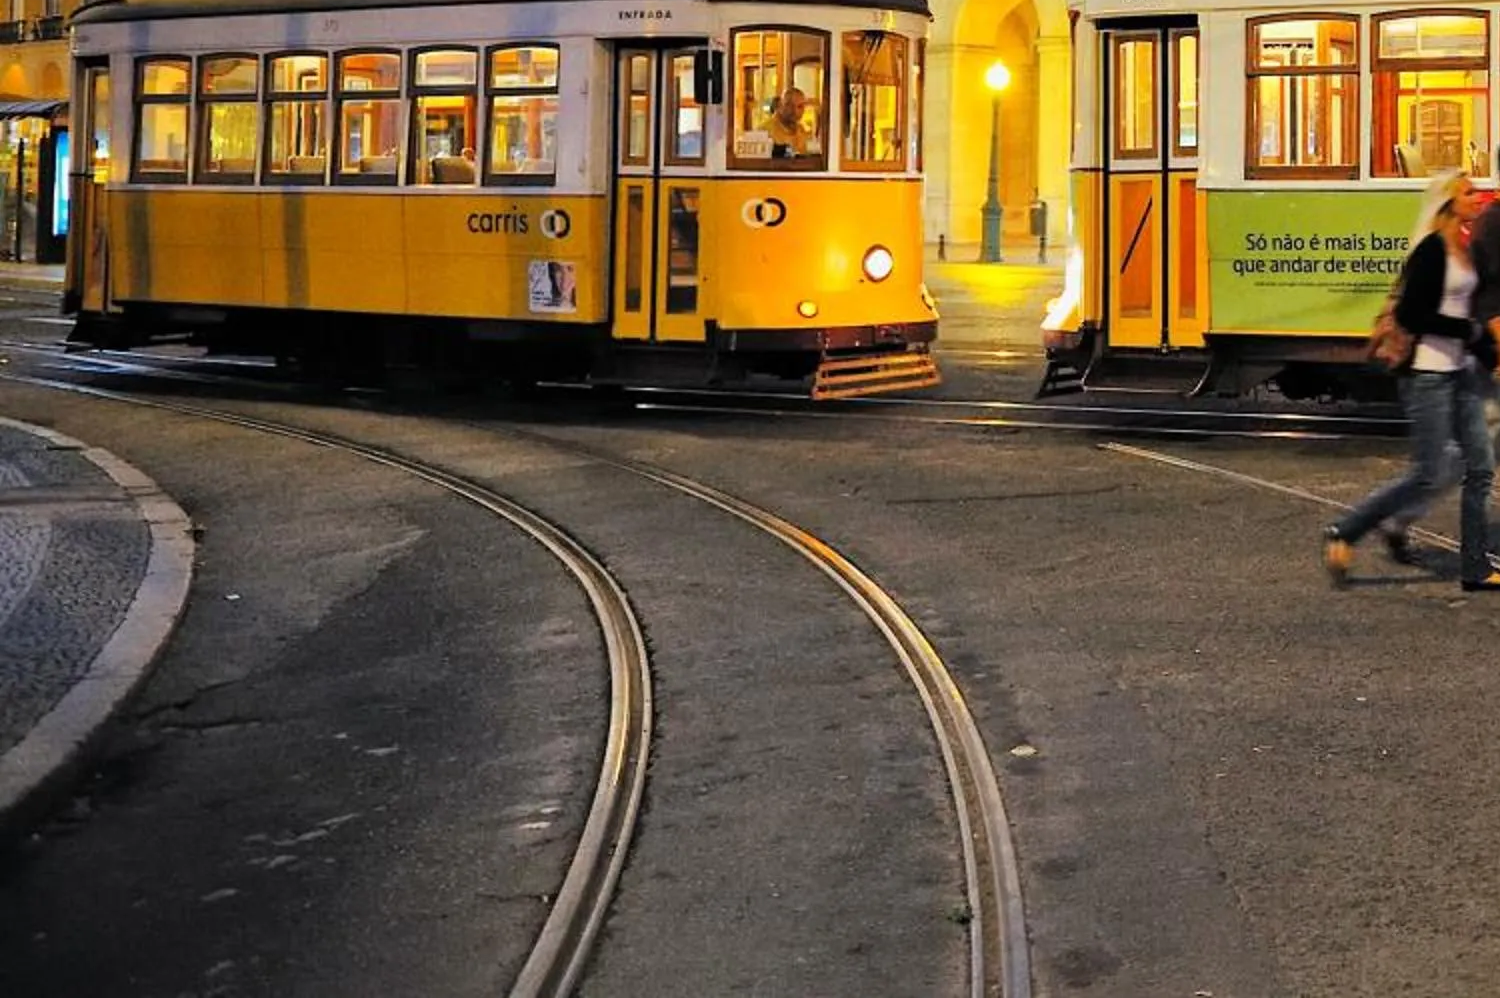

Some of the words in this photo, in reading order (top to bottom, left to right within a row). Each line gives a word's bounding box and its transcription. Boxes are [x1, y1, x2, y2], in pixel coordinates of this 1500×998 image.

[467, 204, 529, 235] carris
[1245, 233, 1267, 251] Só
[1271, 234, 1305, 251] não
[1309, 233, 1320, 251] é
[1324, 234, 1366, 251] mais
[1371, 233, 1409, 251] bara
[1232, 260, 1266, 276] que
[1269, 256, 1319, 274] andar
[1324, 256, 1346, 273] de
[1350, 256, 1403, 274] eléctr
